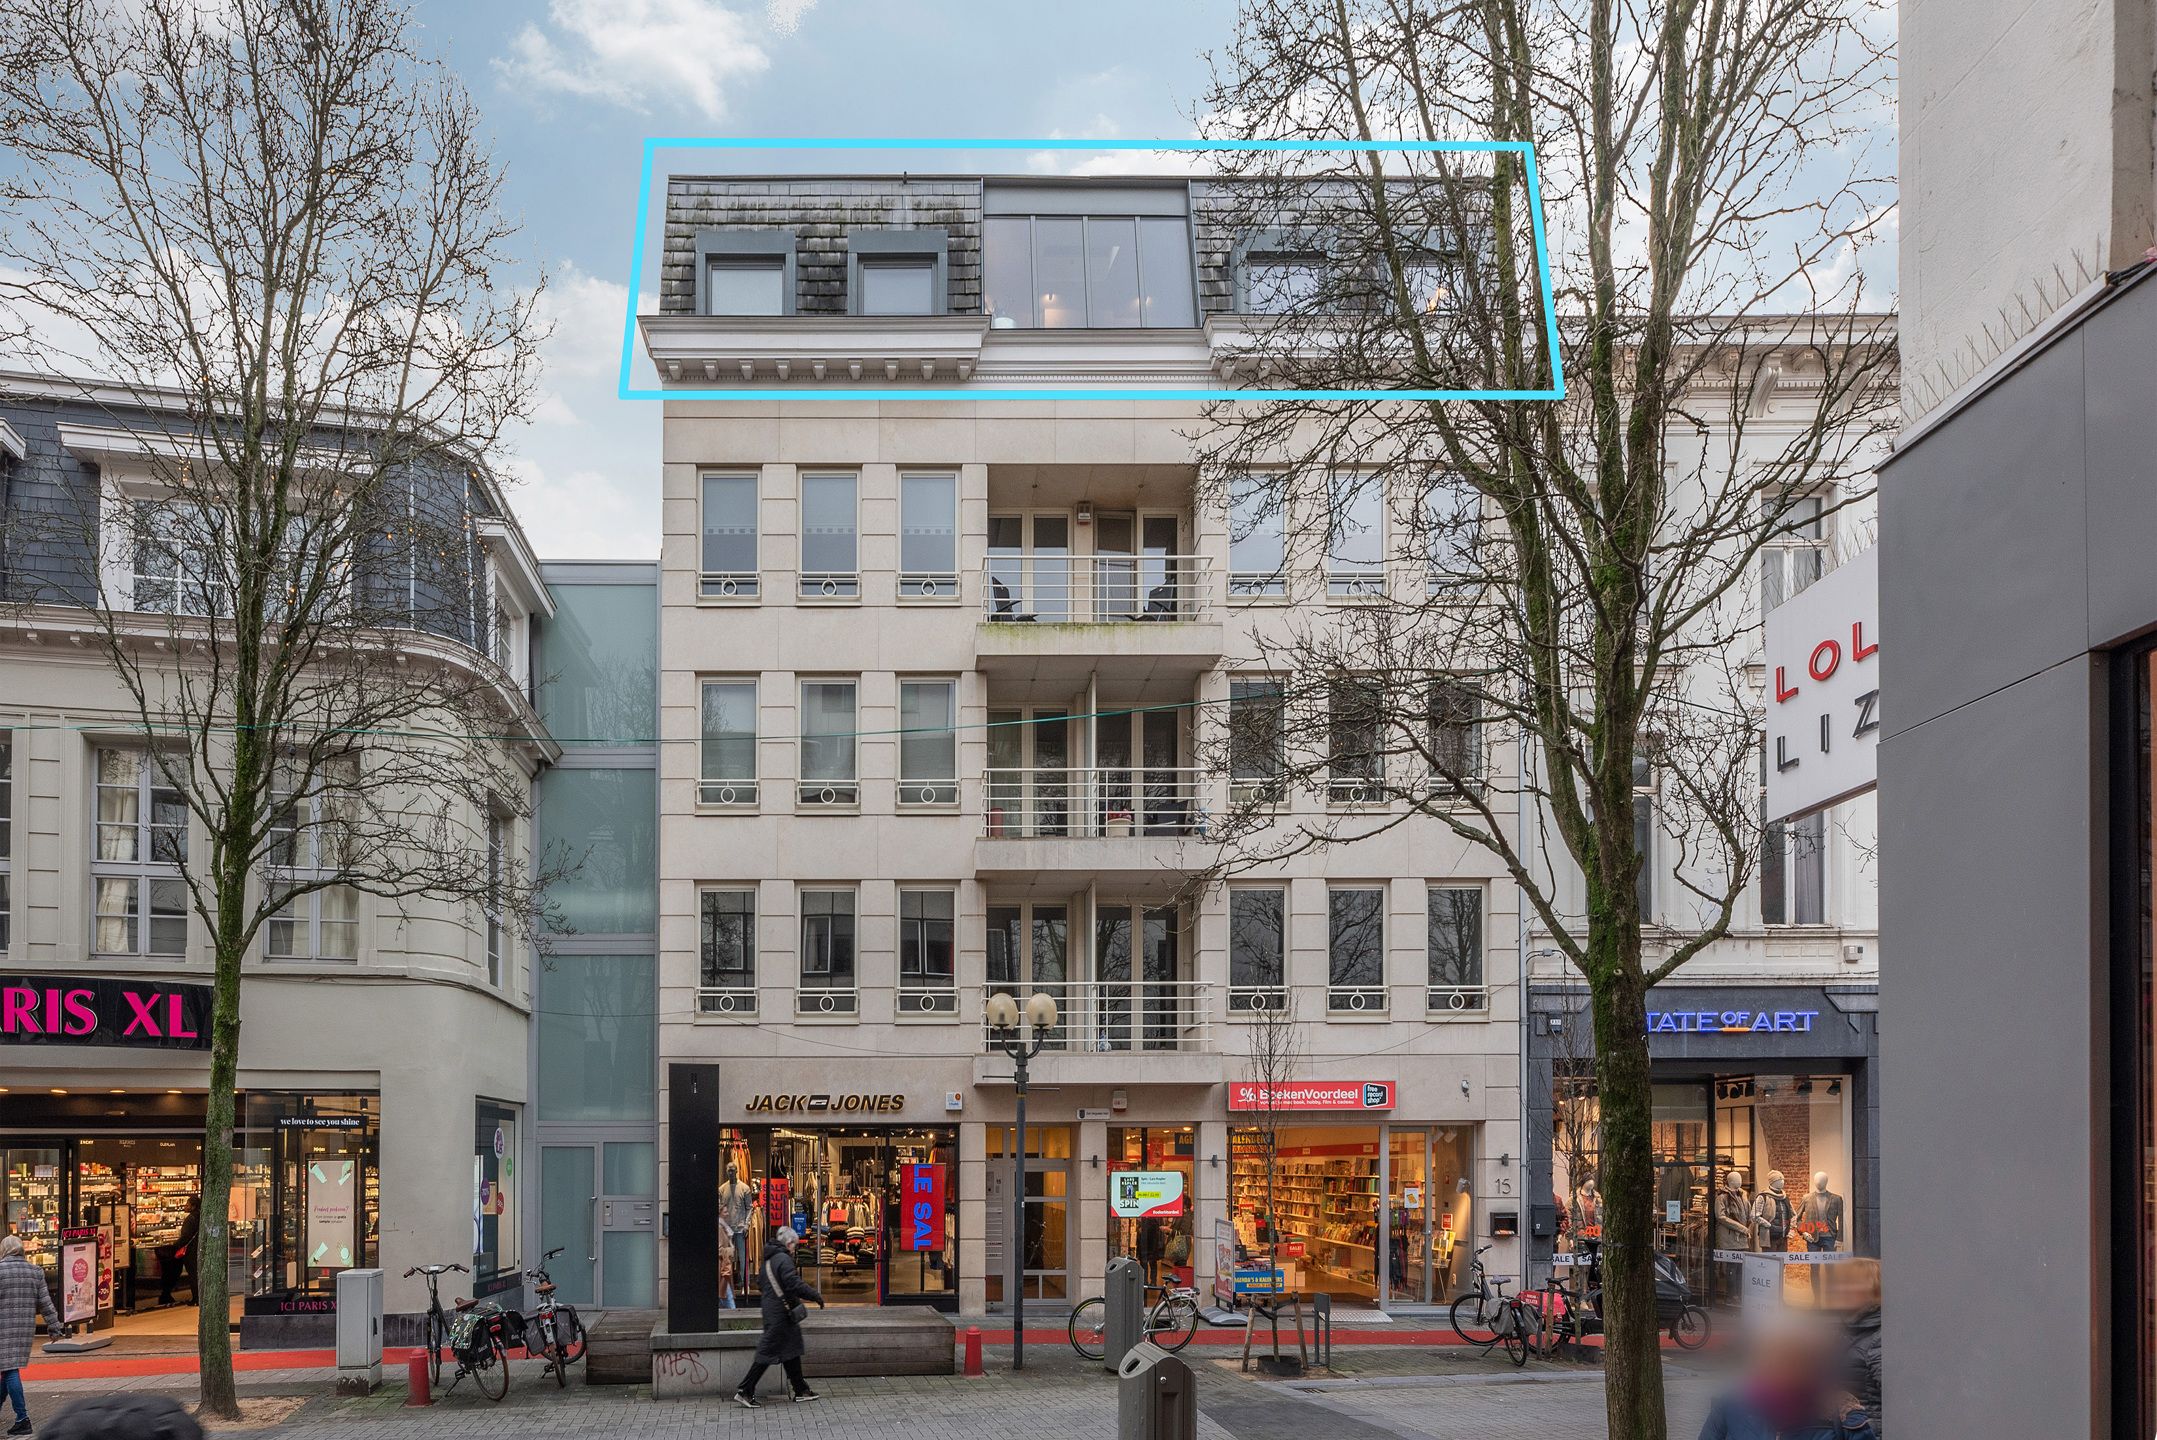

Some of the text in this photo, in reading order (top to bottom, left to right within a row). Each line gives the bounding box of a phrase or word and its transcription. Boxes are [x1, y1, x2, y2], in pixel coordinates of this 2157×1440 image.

[1776, 621, 1879, 704] LOL
[1776, 689, 1880, 773] LIZ
[0, 987, 198, 1039] RIS XL
[1720, 1010, 1750, 1025] OF
[1751, 1011, 1819, 1033] ART
[1259, 1088, 1358, 1100] BoekenVoordeel
[745, 1094, 905, 1112] JACK JONES
[292, 1117, 307, 1126] love
[306, 1118, 314, 1126] to
[326, 1119, 340, 1128] you
[340, 1117, 360, 1126] shine
[1495, 1178, 1512, 1195] 15
[1120, 1200, 1139, 1208] SPIN
[1788, 1253, 1810, 1261] SALE
[1751, 1276, 1771, 1289] SALE
[280, 1301, 295, 1311] ICI
[298, 1300, 328, 1311] PARIS
